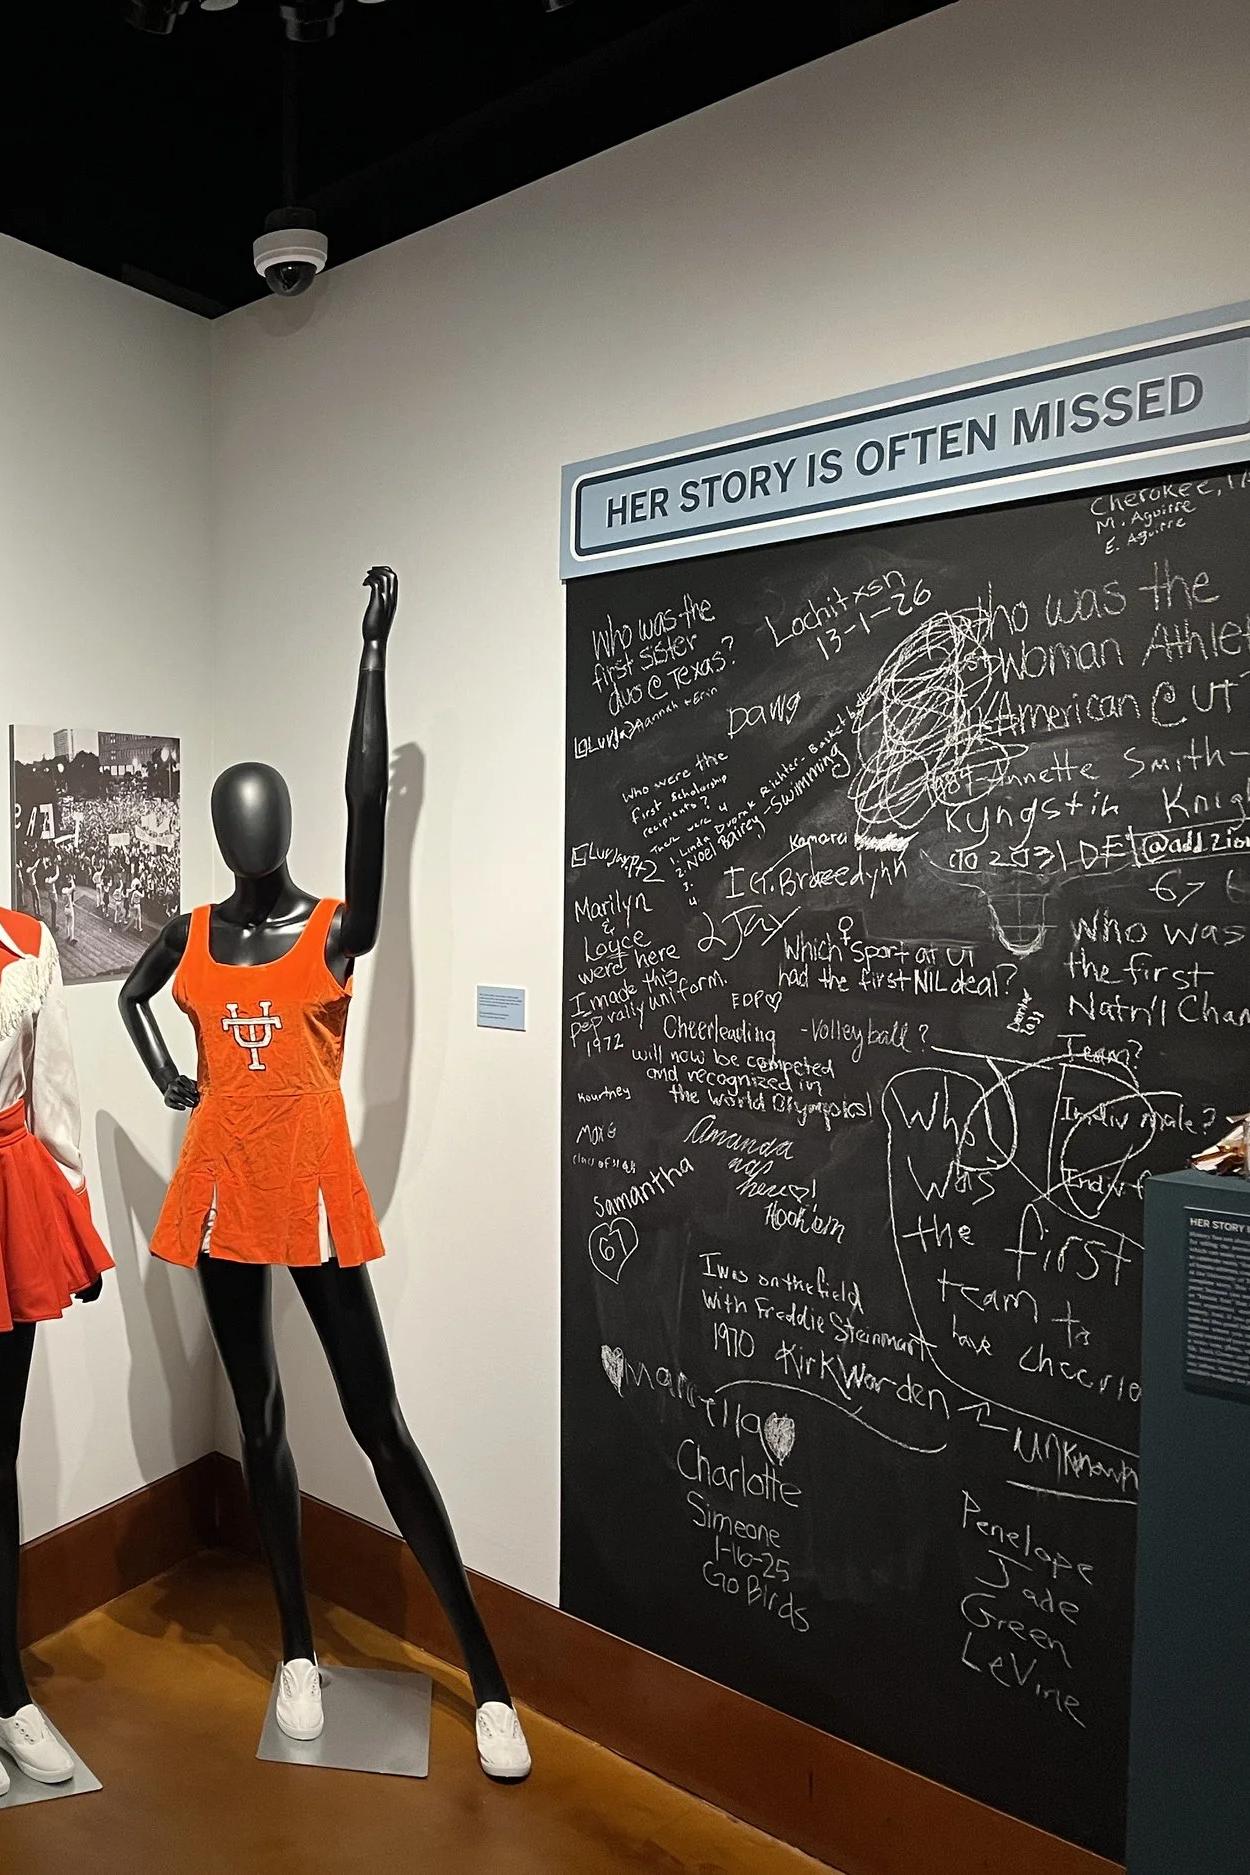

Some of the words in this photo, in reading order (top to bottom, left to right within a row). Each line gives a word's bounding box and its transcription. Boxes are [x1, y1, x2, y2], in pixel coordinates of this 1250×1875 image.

[606, 487, 670, 529] HER
[678, 456, 800, 514] STORY
[806, 448, 843, 489] IS
[855, 413, 997, 477] OFTEN
[1012, 372, 1205, 447] MISSED
[1044, 580, 1128, 627] was
[1139, 559, 1221, 613] the
[591, 613, 633, 660] Who
[637, 609, 680, 641] was
[678, 592, 716, 630] the
[592, 656, 635, 693] first
[639, 632, 697, 673] sister
[608, 686, 644, 717] duo
[648, 674, 669, 701] @
[1192, 679, 1239, 714] UT
[654, 769, 692, 789] were
[695, 752, 729, 772] the
[574, 889, 654, 929] Marilyn
[1070, 907, 1149, 945] Who
[634, 944, 681, 969] here
[783, 929, 843, 963] Which
[915, 943, 939, 965] at
[946, 946, 975, 968] UT
[642, 968, 679, 994] this
[779, 963, 809, 989] had
[818, 964, 850, 993] the
[858, 967, 912, 992] first
[914, 968, 948, 996] NIL
[1063, 947, 1124, 985] the
[1123, 951, 1215, 991] first
[607, 1000, 645, 1031] rally
[663, 1014, 777, 1055] Cheerleading
[586, 1032, 624, 1058] 1972
[631, 1043, 663, 1064] will
[670, 1049, 705, 1065] now
[713, 1047, 740, 1067] be
[646, 1064, 679, 1082] and
[687, 1067, 794, 1097] recognized
[669, 1083, 700, 1104] the
[593, 1156, 695, 1218] Samantha
[902, 1213, 975, 1253] the
[1190, 1217, 1210, 1228] HER
[1212, 1220, 1245, 1233] STORY
[758, 1274, 780, 1289] on
[781, 1272, 815, 1296] the
[816, 1266, 865, 1315] field
[714, 1322, 756, 1358] 1970
[676, 1438, 802, 1509] Charlotte
[686, 1490, 781, 1549] Simeone
[961, 1489, 1095, 1586] Penelope
[703, 1560, 740, 1594] Go
[975, 1549, 1080, 1626] Jade
[960, 1592, 1073, 1669] Green
